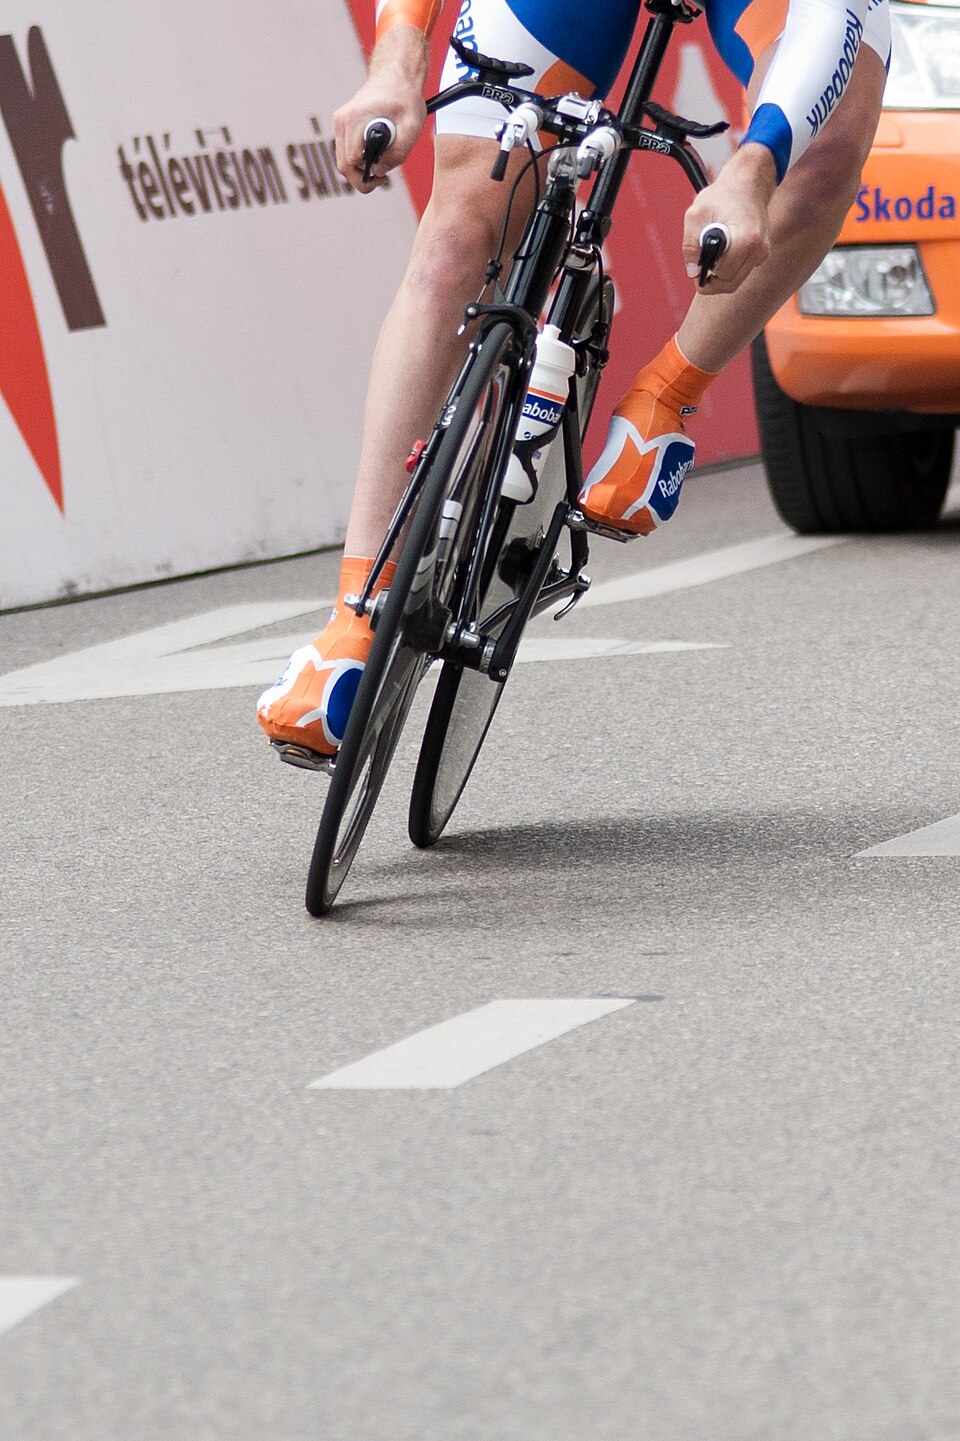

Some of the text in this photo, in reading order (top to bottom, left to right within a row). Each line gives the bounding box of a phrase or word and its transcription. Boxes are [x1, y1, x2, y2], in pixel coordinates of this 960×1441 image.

[482, 86, 515, 105] PRO
[639, 136, 671, 156] PRO
[118, 126, 289, 223] télévision
[856, 184, 956, 222] Škoda
